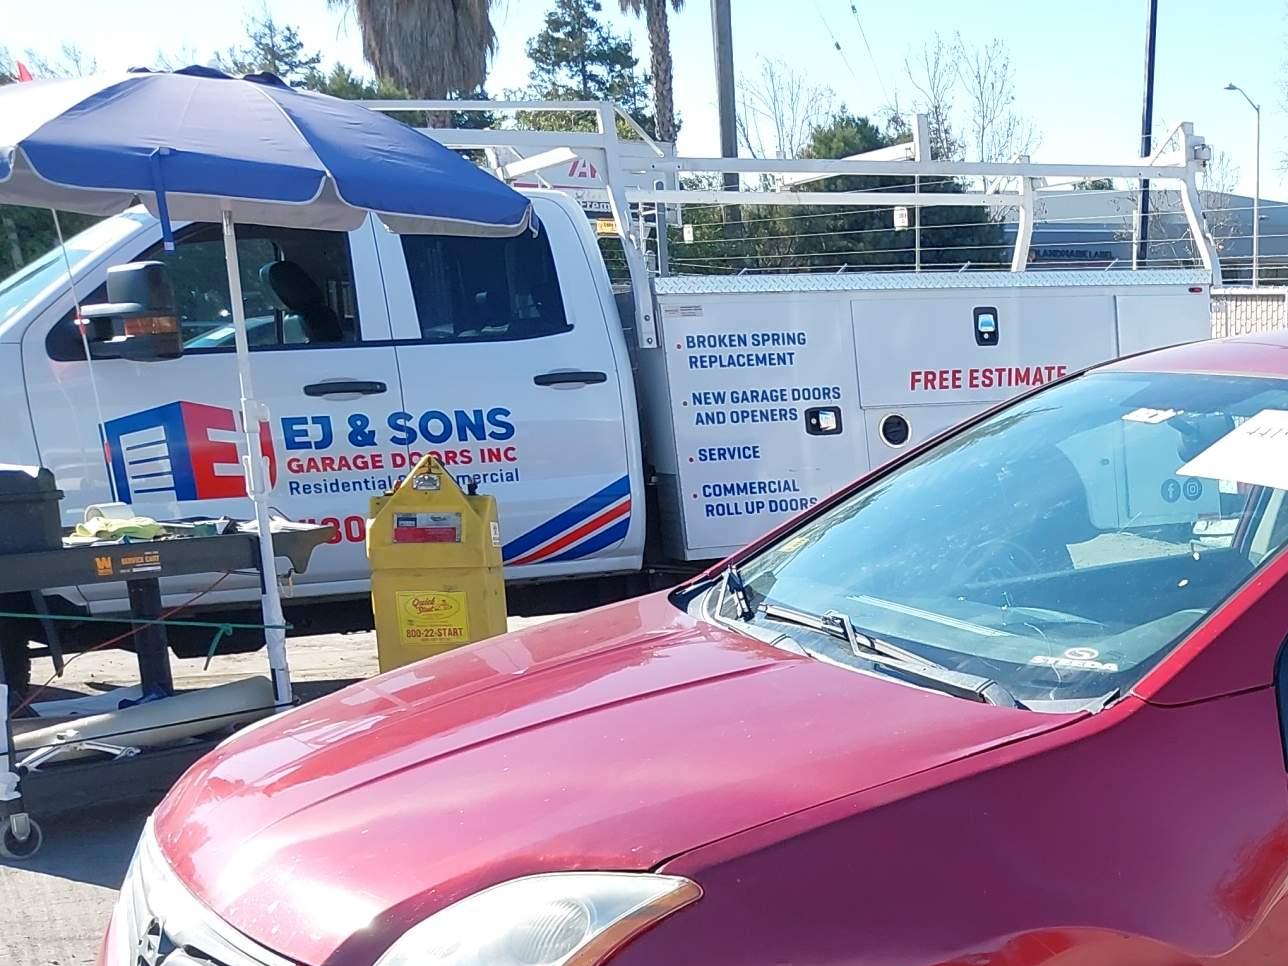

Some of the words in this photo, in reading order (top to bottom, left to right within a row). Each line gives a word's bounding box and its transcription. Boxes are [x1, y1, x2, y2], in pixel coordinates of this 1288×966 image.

[685, 334, 748, 349] BROKEN
[751, 332, 807, 347] SPRING
[688, 352, 796, 369] REPLACEMENT
[910, 369, 962, 391] FREE
[692, 391, 727, 406] NEW
[730, 389, 788, 404] GARAGE
[791, 386, 841, 402] DOORS
[695, 411, 726, 425] AND
[730, 408, 798, 423] OPENERS
[281, 415, 333, 451] EJ
[347, 413, 378, 447] &
[387, 407, 516, 446] SONS
[286, 453, 384, 474] GARAGE
[480, 446, 518, 464] INC
[698, 445, 761, 462] SERVICE
[288, 474, 392, 496] Residential
[702, 479, 800, 498] COMMERCIAL
[705, 503, 742, 517] ROLL
[745, 500, 766, 514] UP
[768, 496, 818, 513] DOORS
[407, 627, 464, 639] 800-22-START
